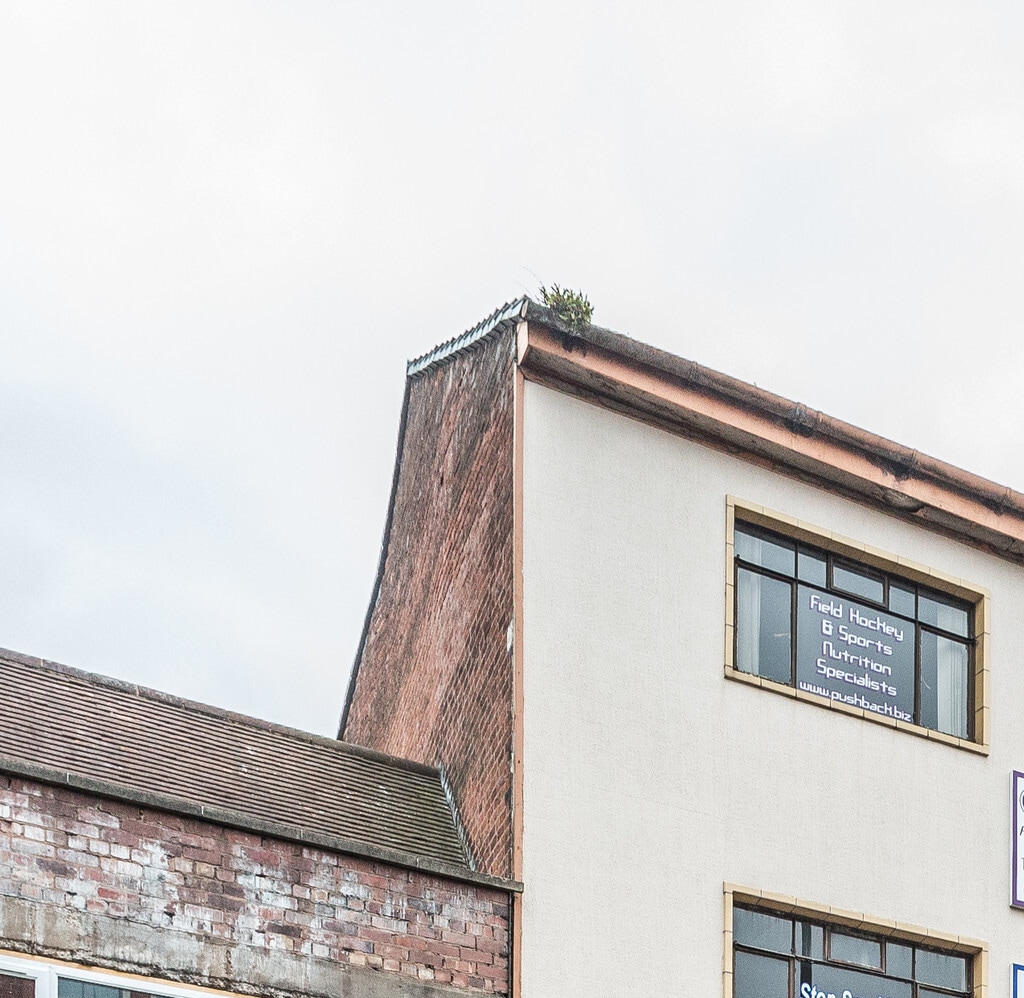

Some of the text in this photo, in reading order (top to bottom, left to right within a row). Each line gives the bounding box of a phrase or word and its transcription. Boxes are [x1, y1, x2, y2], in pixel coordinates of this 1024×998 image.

[810, 595, 903, 641] Field Hockey
[822, 620, 893, 655] & Sports
[817, 658, 897, 696] Specialists
[823, 641, 891, 676] Nutrition
[799, 681, 912, 722] www.pushback.biz
